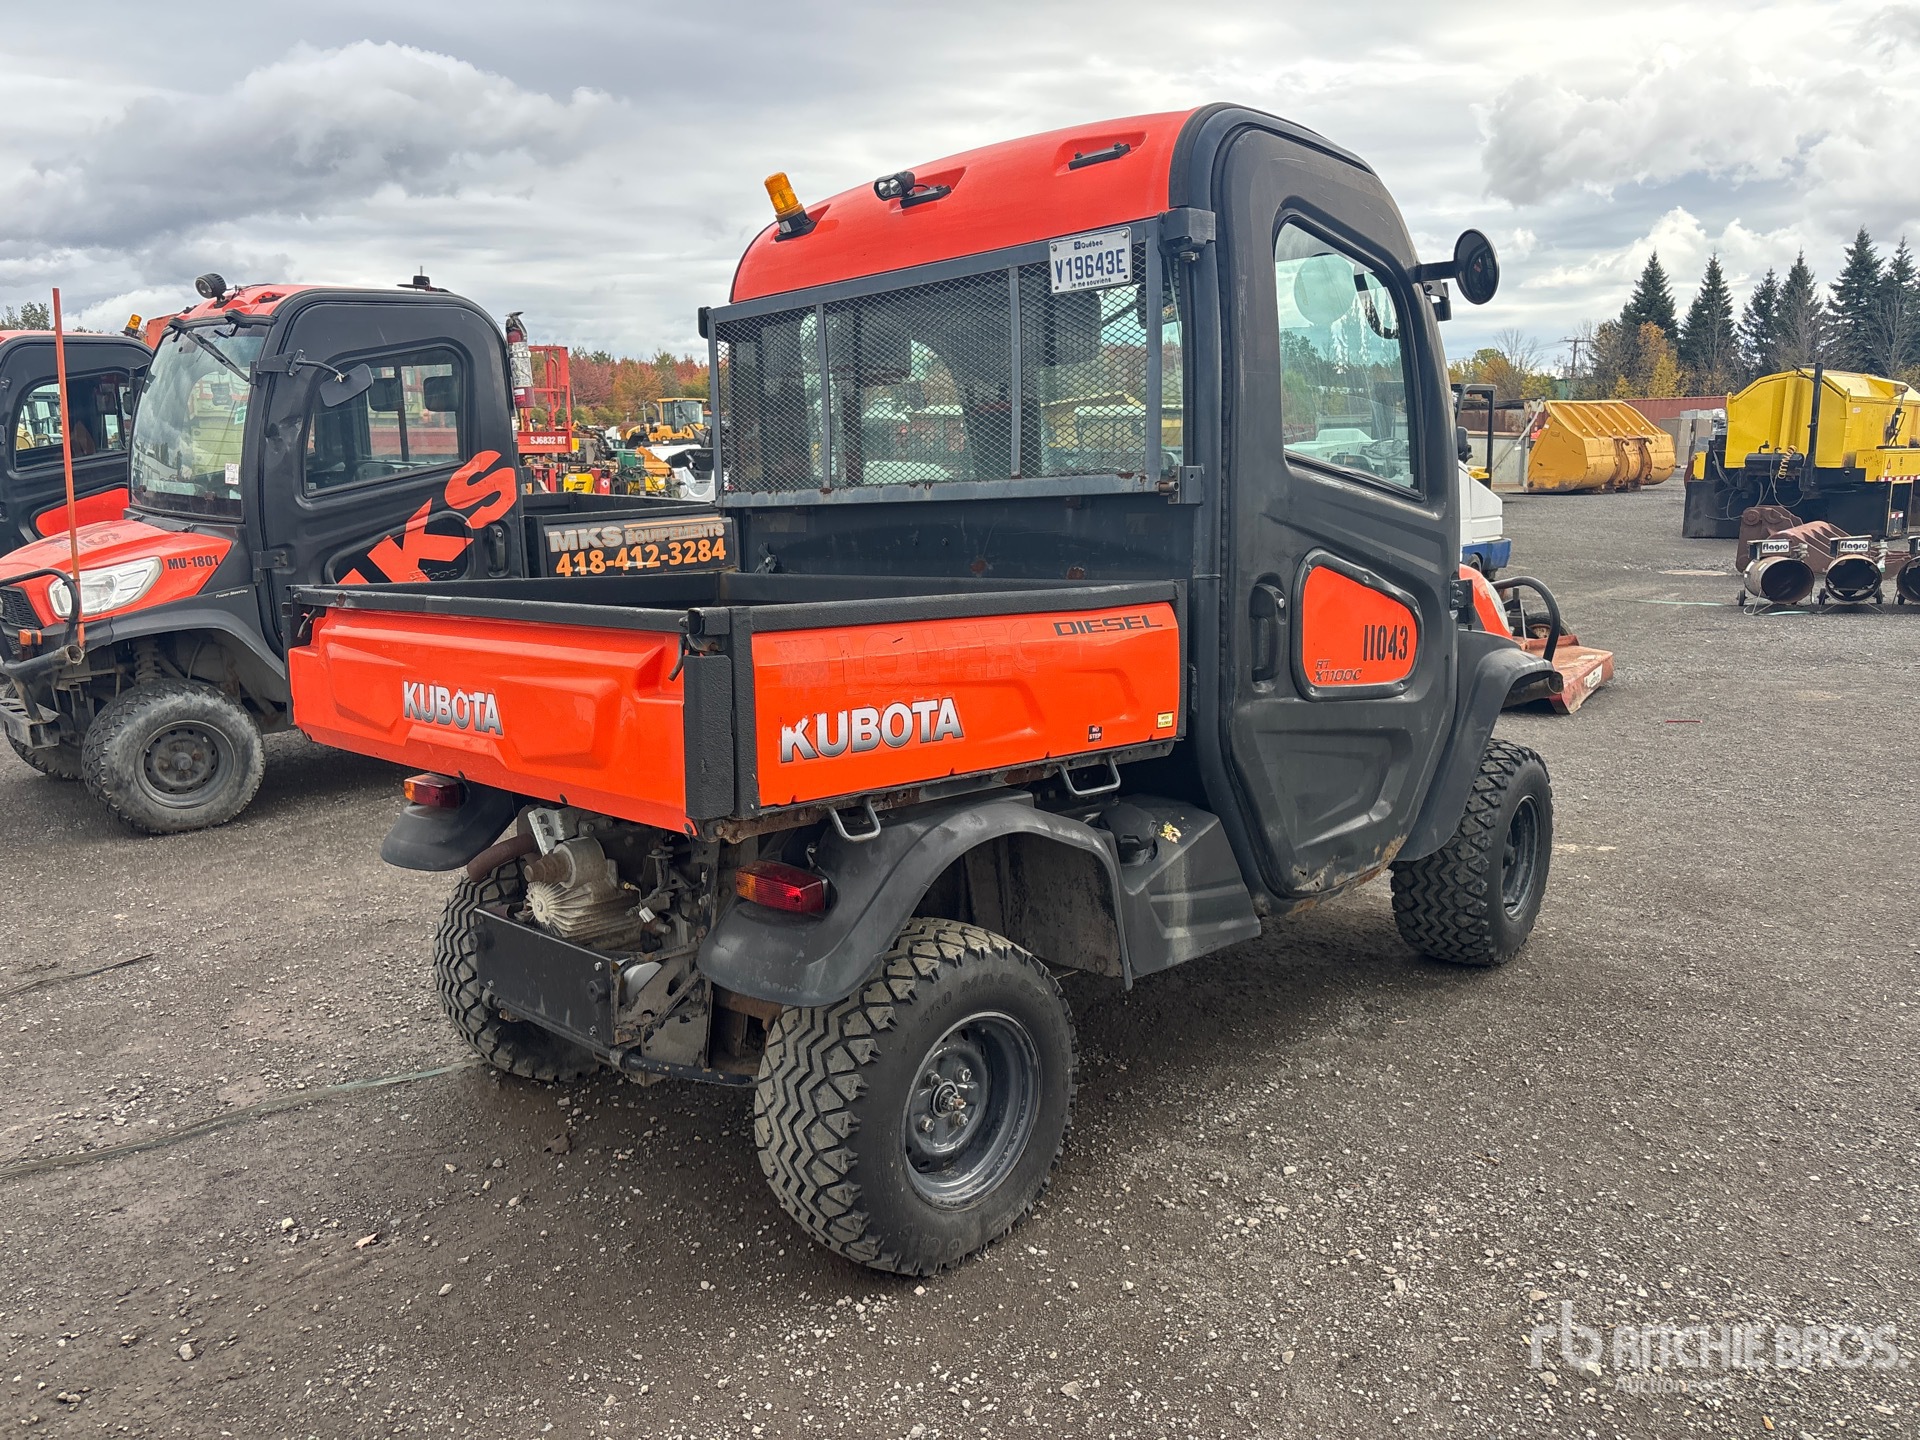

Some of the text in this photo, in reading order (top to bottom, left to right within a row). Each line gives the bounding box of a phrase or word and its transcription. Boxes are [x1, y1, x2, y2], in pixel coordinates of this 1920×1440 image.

[1081, 240, 1103, 249] Québec
[1055, 248, 1126, 283] V19643E
[1087, 278, 1111, 286] souviens
[530, 435, 567, 445] SJ6832 RT
[338, 450, 517, 584] KS
[549, 526, 624, 552] MKS
[1762, 543, 1789, 552] flagro
[1840, 542, 1868, 551] flagro
[167, 555, 220, 570] MU-1801
[556, 538, 727, 577] 418-412-3284
[1053, 614, 1163, 636] DIESEL
[1362, 624, 1409, 662] 11043
[1313, 668, 1363, 683] X1100C
[403, 680, 504, 736] KUBOTA
[780, 696, 965, 764] KUBOTA
